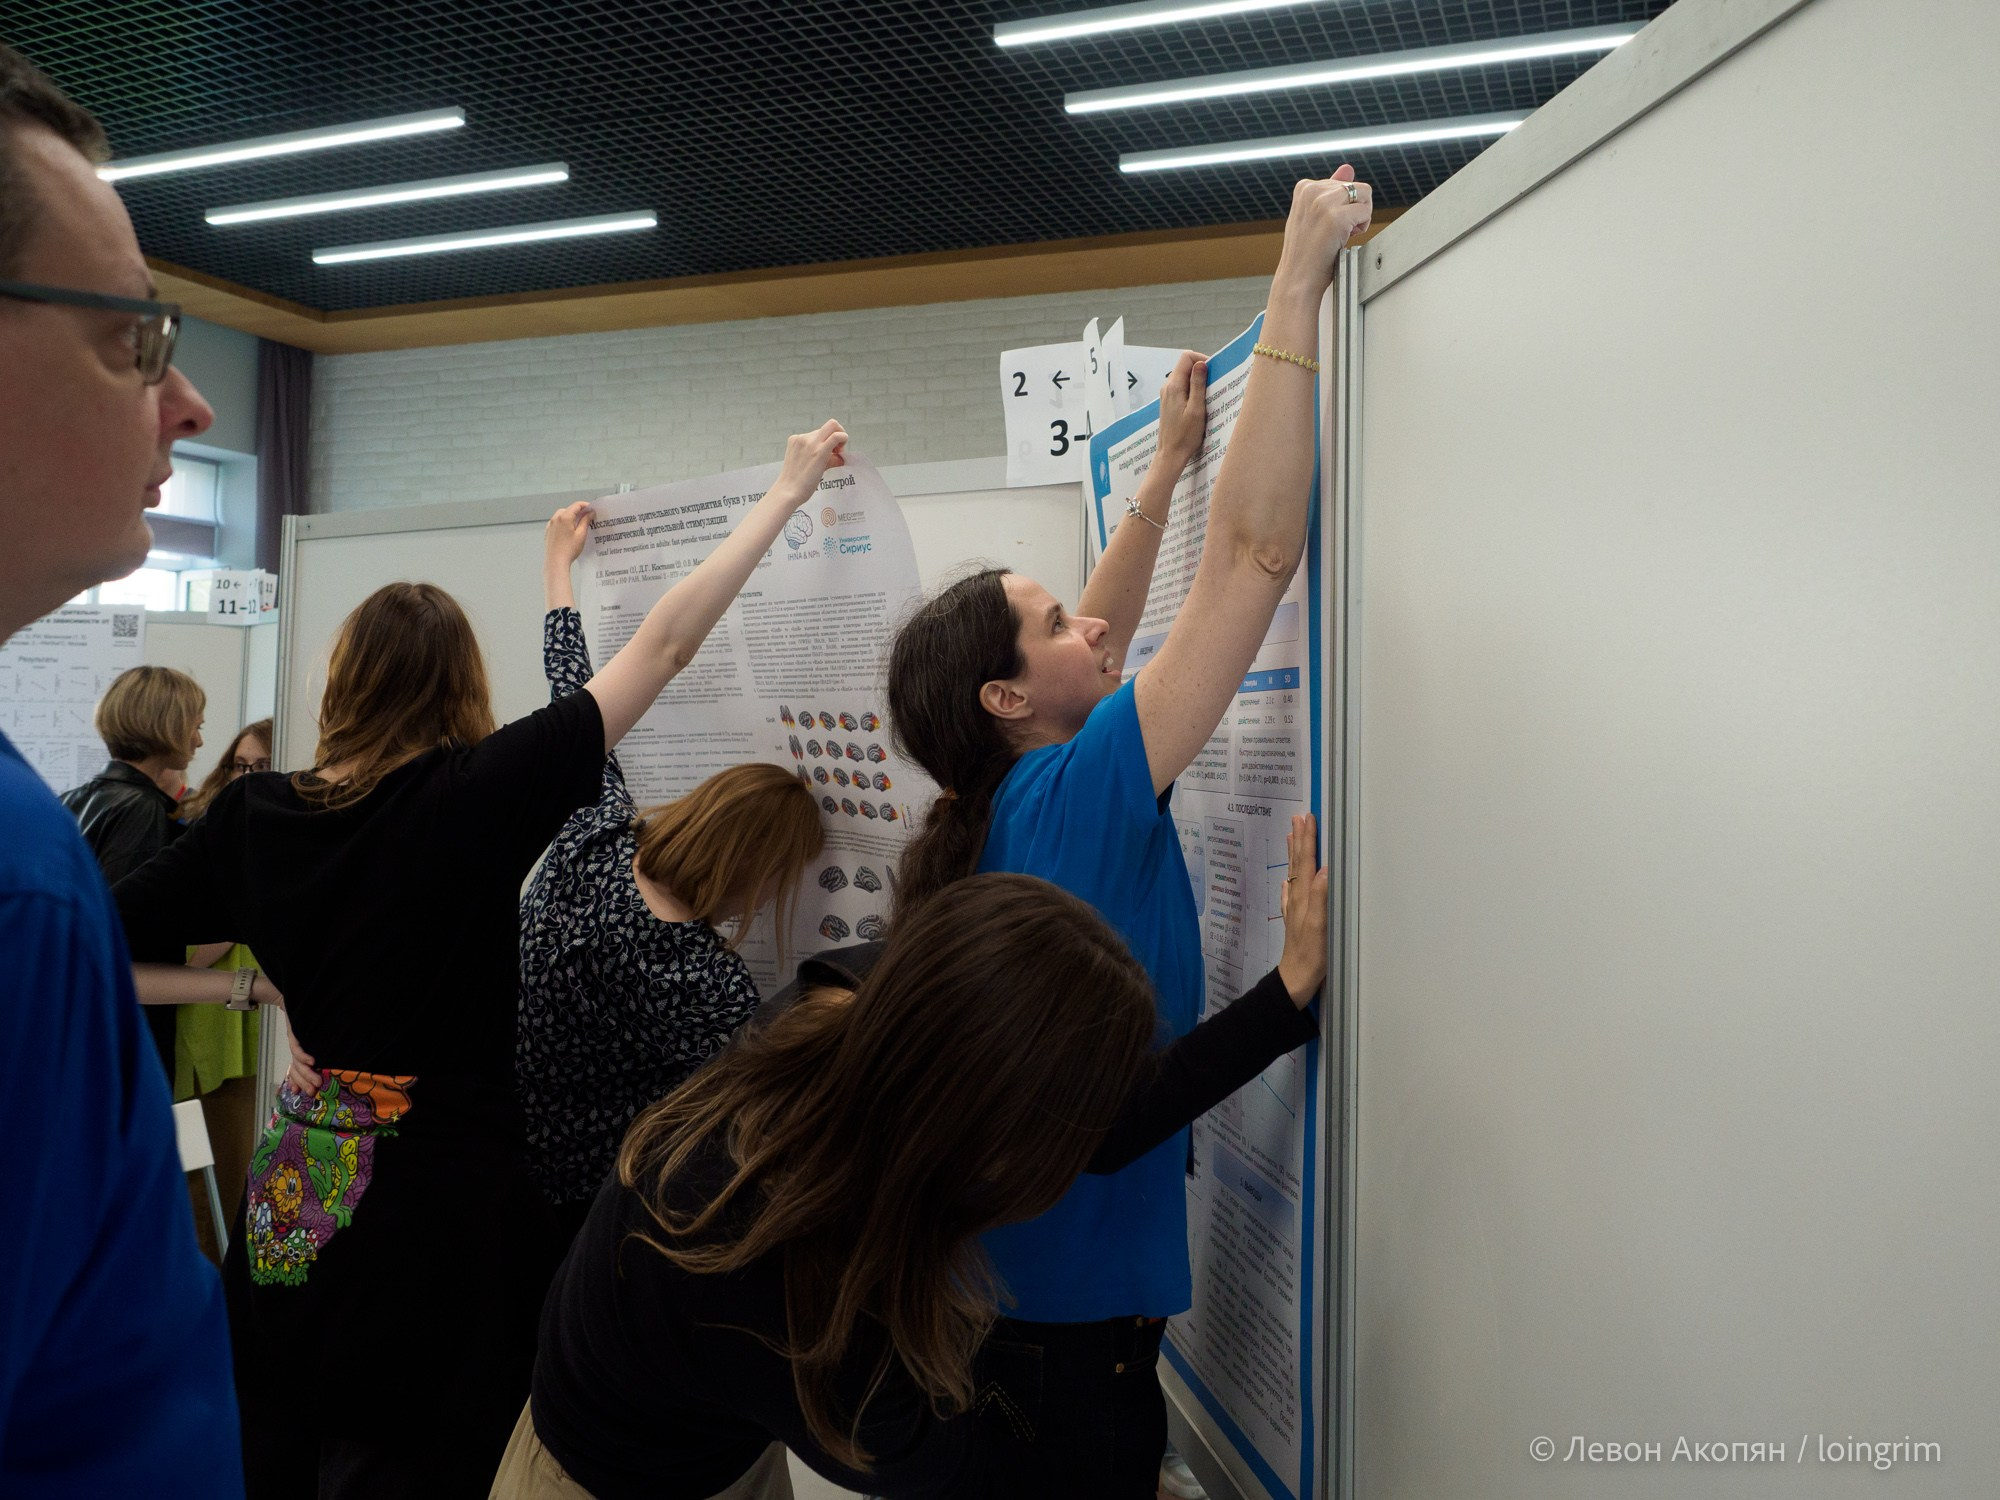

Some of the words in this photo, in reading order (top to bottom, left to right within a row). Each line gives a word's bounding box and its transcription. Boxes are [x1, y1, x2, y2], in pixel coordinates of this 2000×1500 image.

[1012, 371, 1028, 397] 2
[820, 474, 856, 490] быстрой
[589, 514, 637, 530] Исследование
[638, 507, 680, 523] зрительного
[681, 499, 722, 514] восприятия
[723, 495, 741, 508] букв
[594, 526, 645, 545] периодической
[646, 520, 685, 537] зрительной
[686, 515, 728, 529] стимуляции
[840, 543, 872, 555] Сириус
[787, 552, 802, 561] IHNA
[216, 579, 230, 590] 10
[1235, 804, 1272, 817] ПОСЛЕДЕЙСТВИЕ
